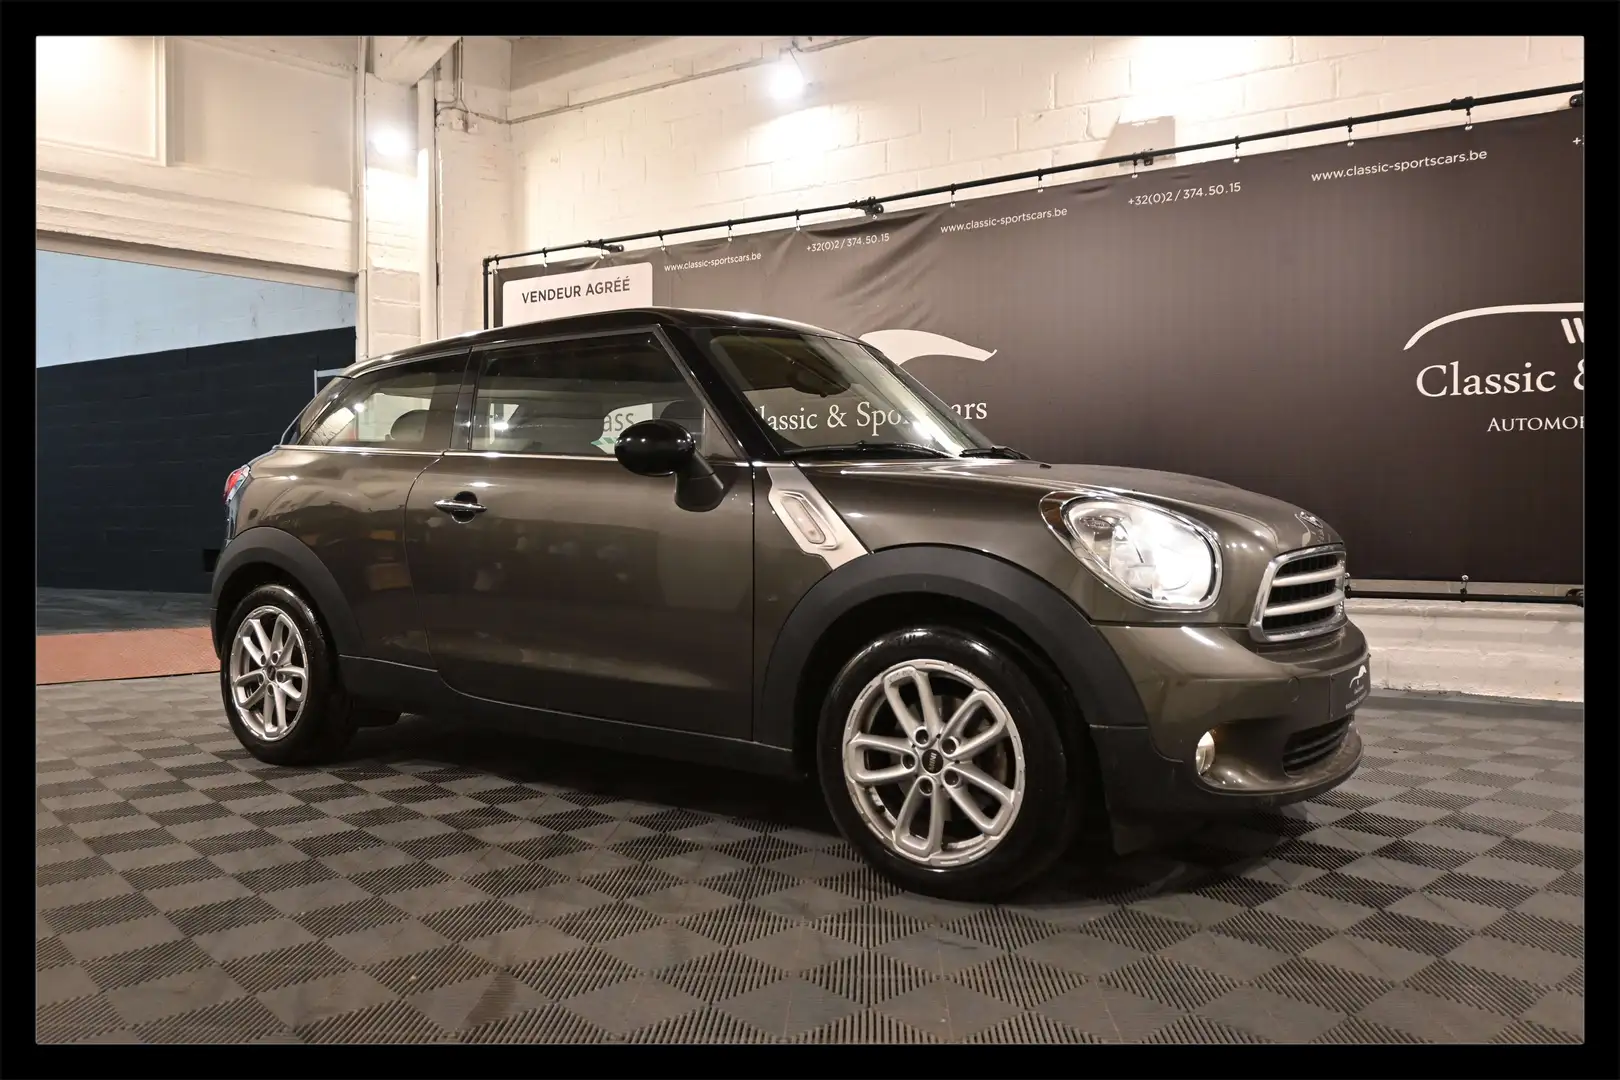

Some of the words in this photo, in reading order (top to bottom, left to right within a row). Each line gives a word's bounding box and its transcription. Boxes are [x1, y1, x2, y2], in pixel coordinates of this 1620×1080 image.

[1311, 150, 1488, 182] www.classic-sportscars.be
[939, 206, 1068, 234] www.classic-sportscars.be
[663, 251, 762, 272] www.classic-sportscars.be
[521, 285, 582, 304] VENDEUR
[585, 275, 631, 297] AGRÉÉ
[1415, 360, 1557, 398] Classic
[755, 405, 818, 431] lassic
[826, 404, 848, 429] &
